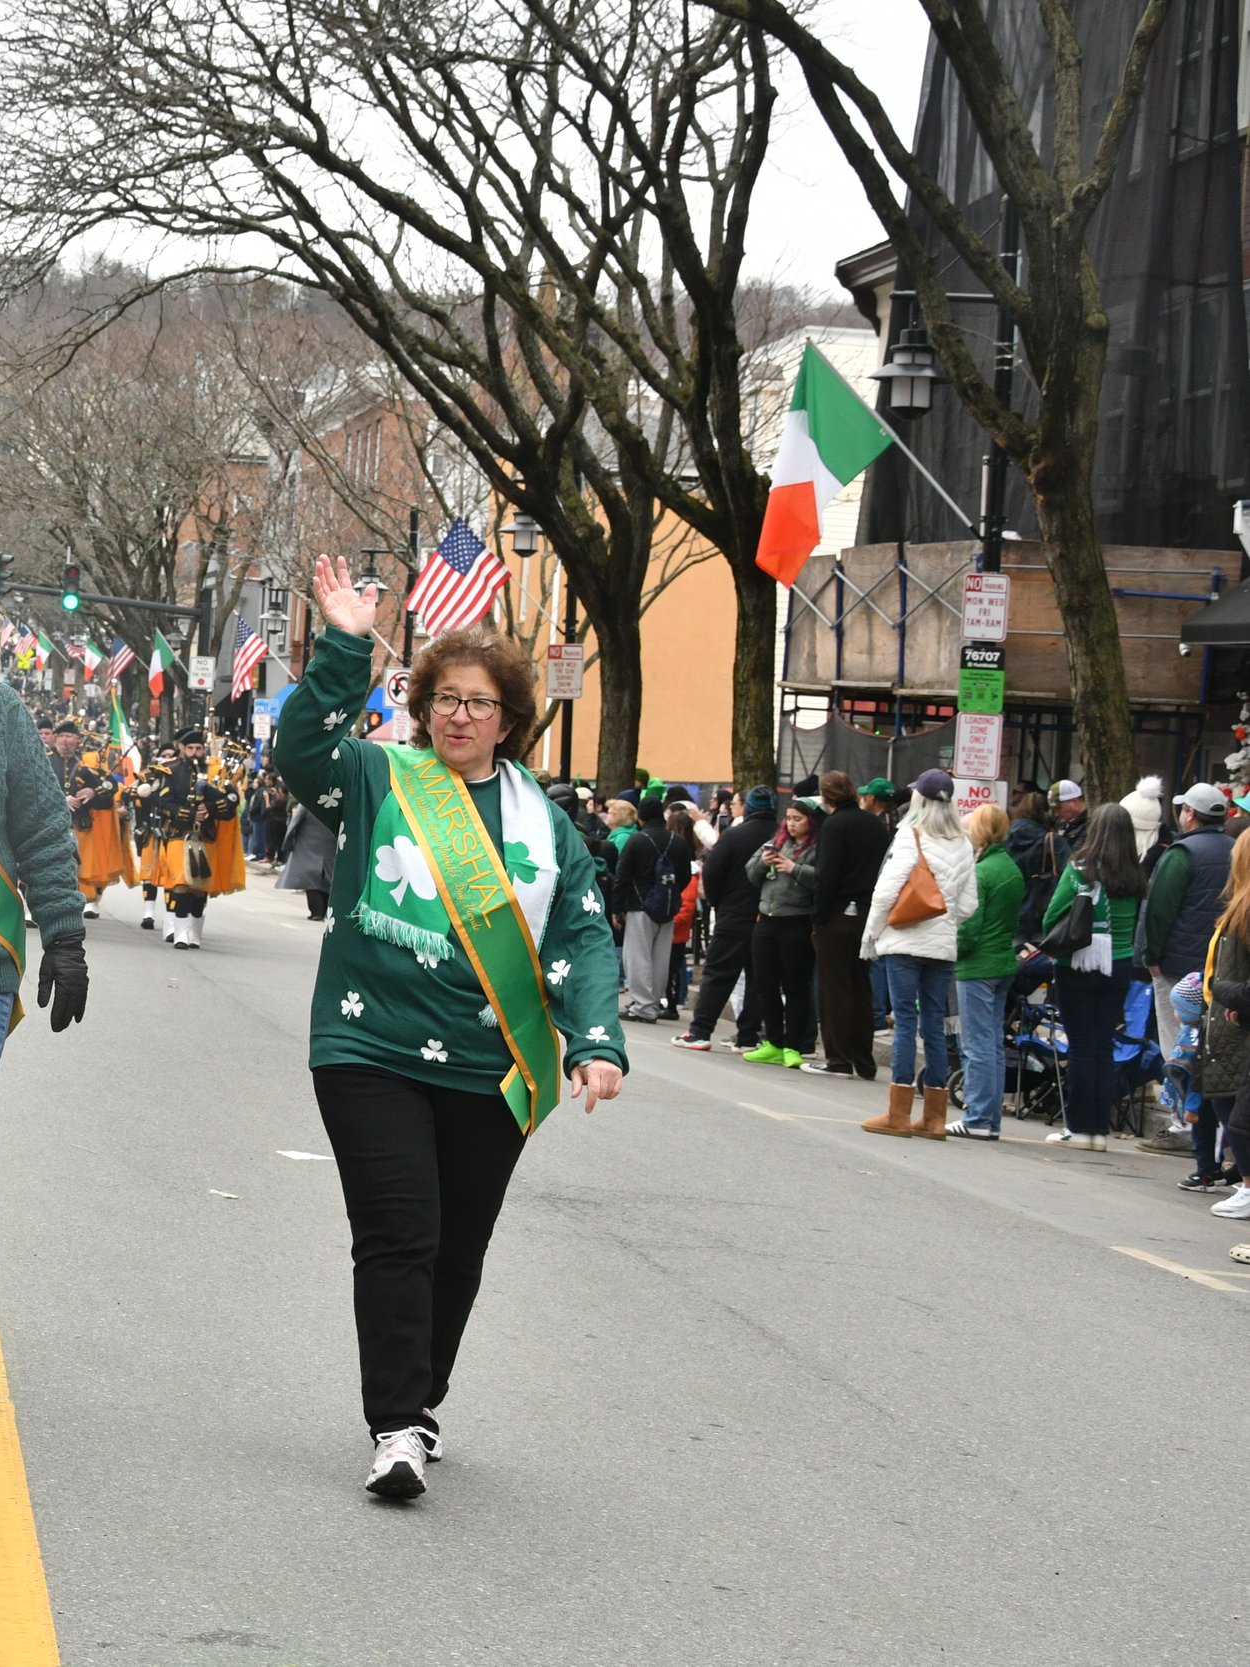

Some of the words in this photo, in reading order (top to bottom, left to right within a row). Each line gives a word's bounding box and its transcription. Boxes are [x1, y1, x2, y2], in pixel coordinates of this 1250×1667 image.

[966, 577, 982, 590] NO
[966, 597, 984, 605] MON
[988, 598, 1005, 606] WED
[979, 608, 991, 616] FRI
[966, 618, 1001, 627] 7AM-8AM
[550, 647, 560, 657] NO
[965, 651, 1001, 662] 76707
[965, 716, 995, 725] LOADING
[969, 726, 988, 735] ZONE
[969, 736, 986, 744] ONLY
[969, 786, 991, 799] NO
[414, 758, 505, 928] MARSHAL
[455, 882, 467, 902] Day
[463, 904, 482, 932] Parade
